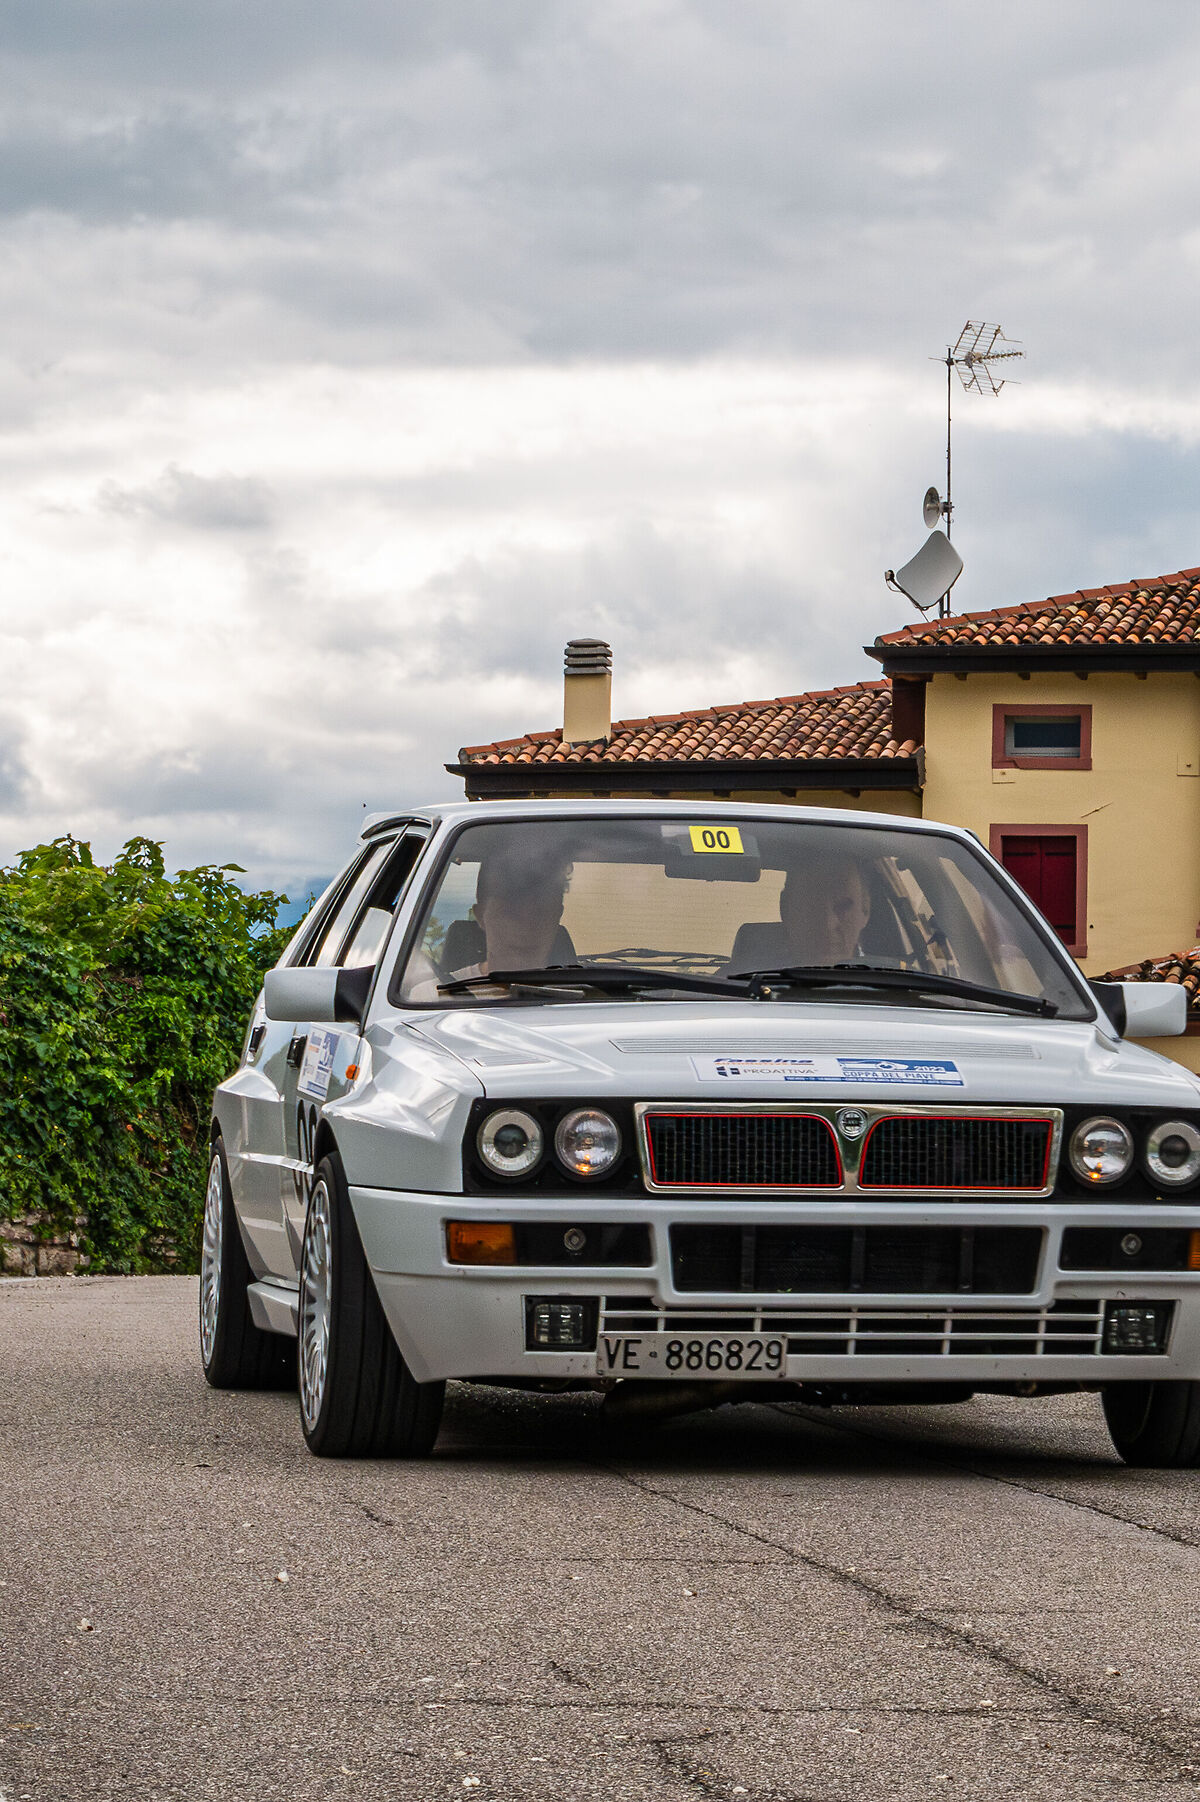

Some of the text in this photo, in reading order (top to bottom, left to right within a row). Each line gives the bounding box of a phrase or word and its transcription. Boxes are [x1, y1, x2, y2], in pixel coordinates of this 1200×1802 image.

[702, 830, 730, 849] 00
[604, 1338, 784, 1372] VE 886829
